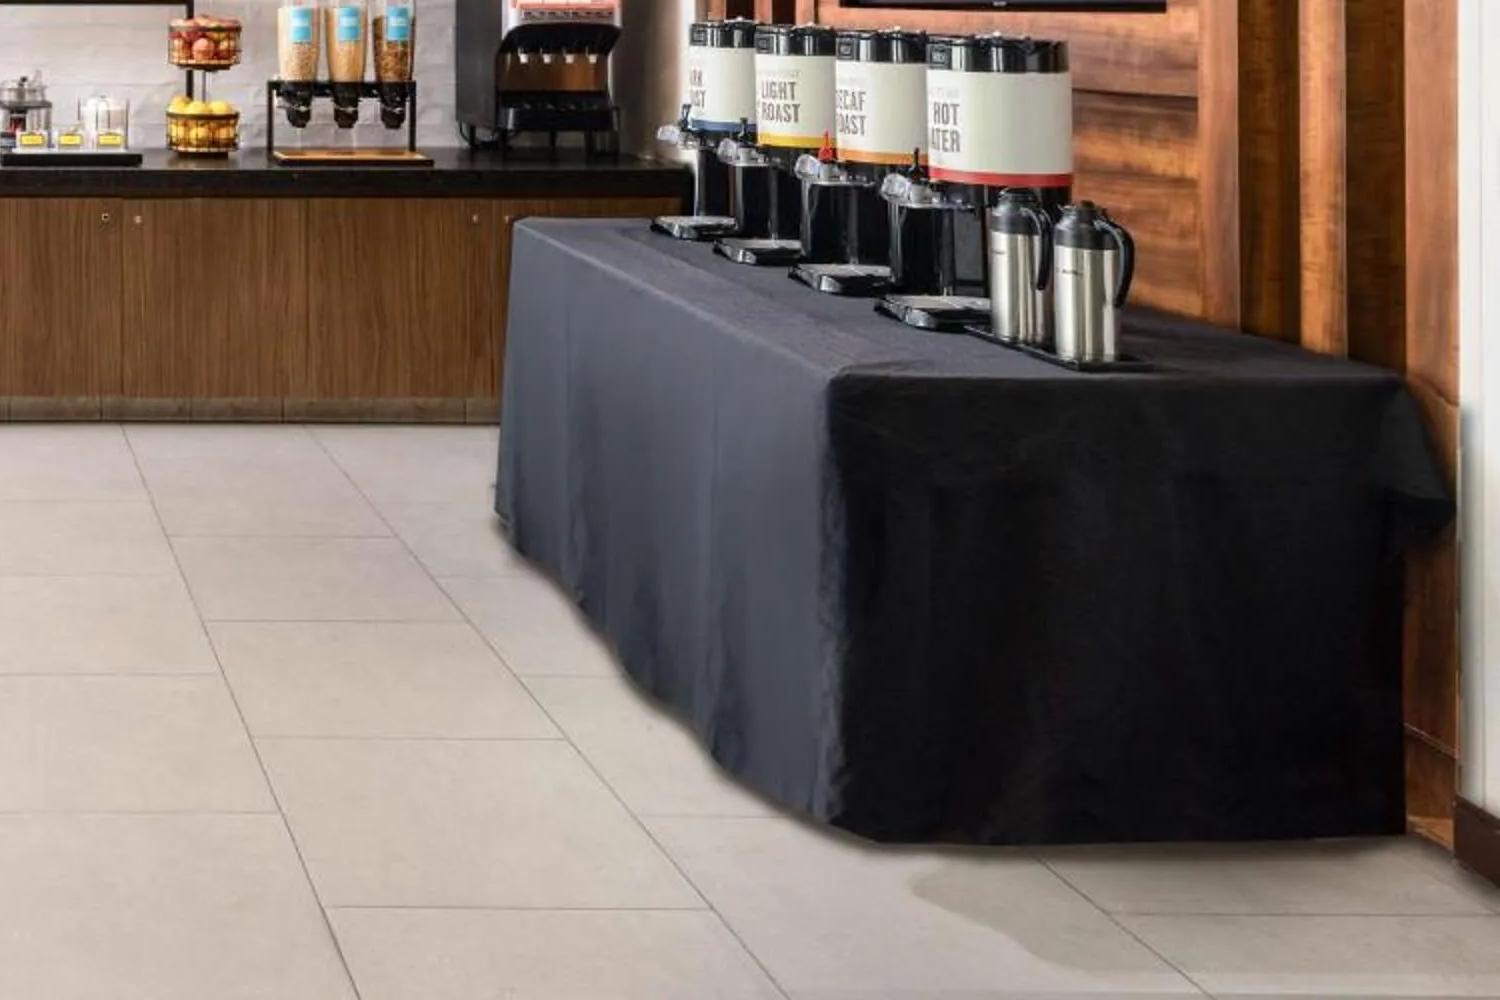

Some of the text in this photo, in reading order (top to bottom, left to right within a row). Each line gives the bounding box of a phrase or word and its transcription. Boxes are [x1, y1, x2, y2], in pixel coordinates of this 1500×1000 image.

[761, 81, 797, 101] LIGHT
[761, 102, 801, 123] ROAST
[933, 101, 960, 125] HOT
[836, 113, 867, 136] OAST
[931, 127, 961, 153] ATER
